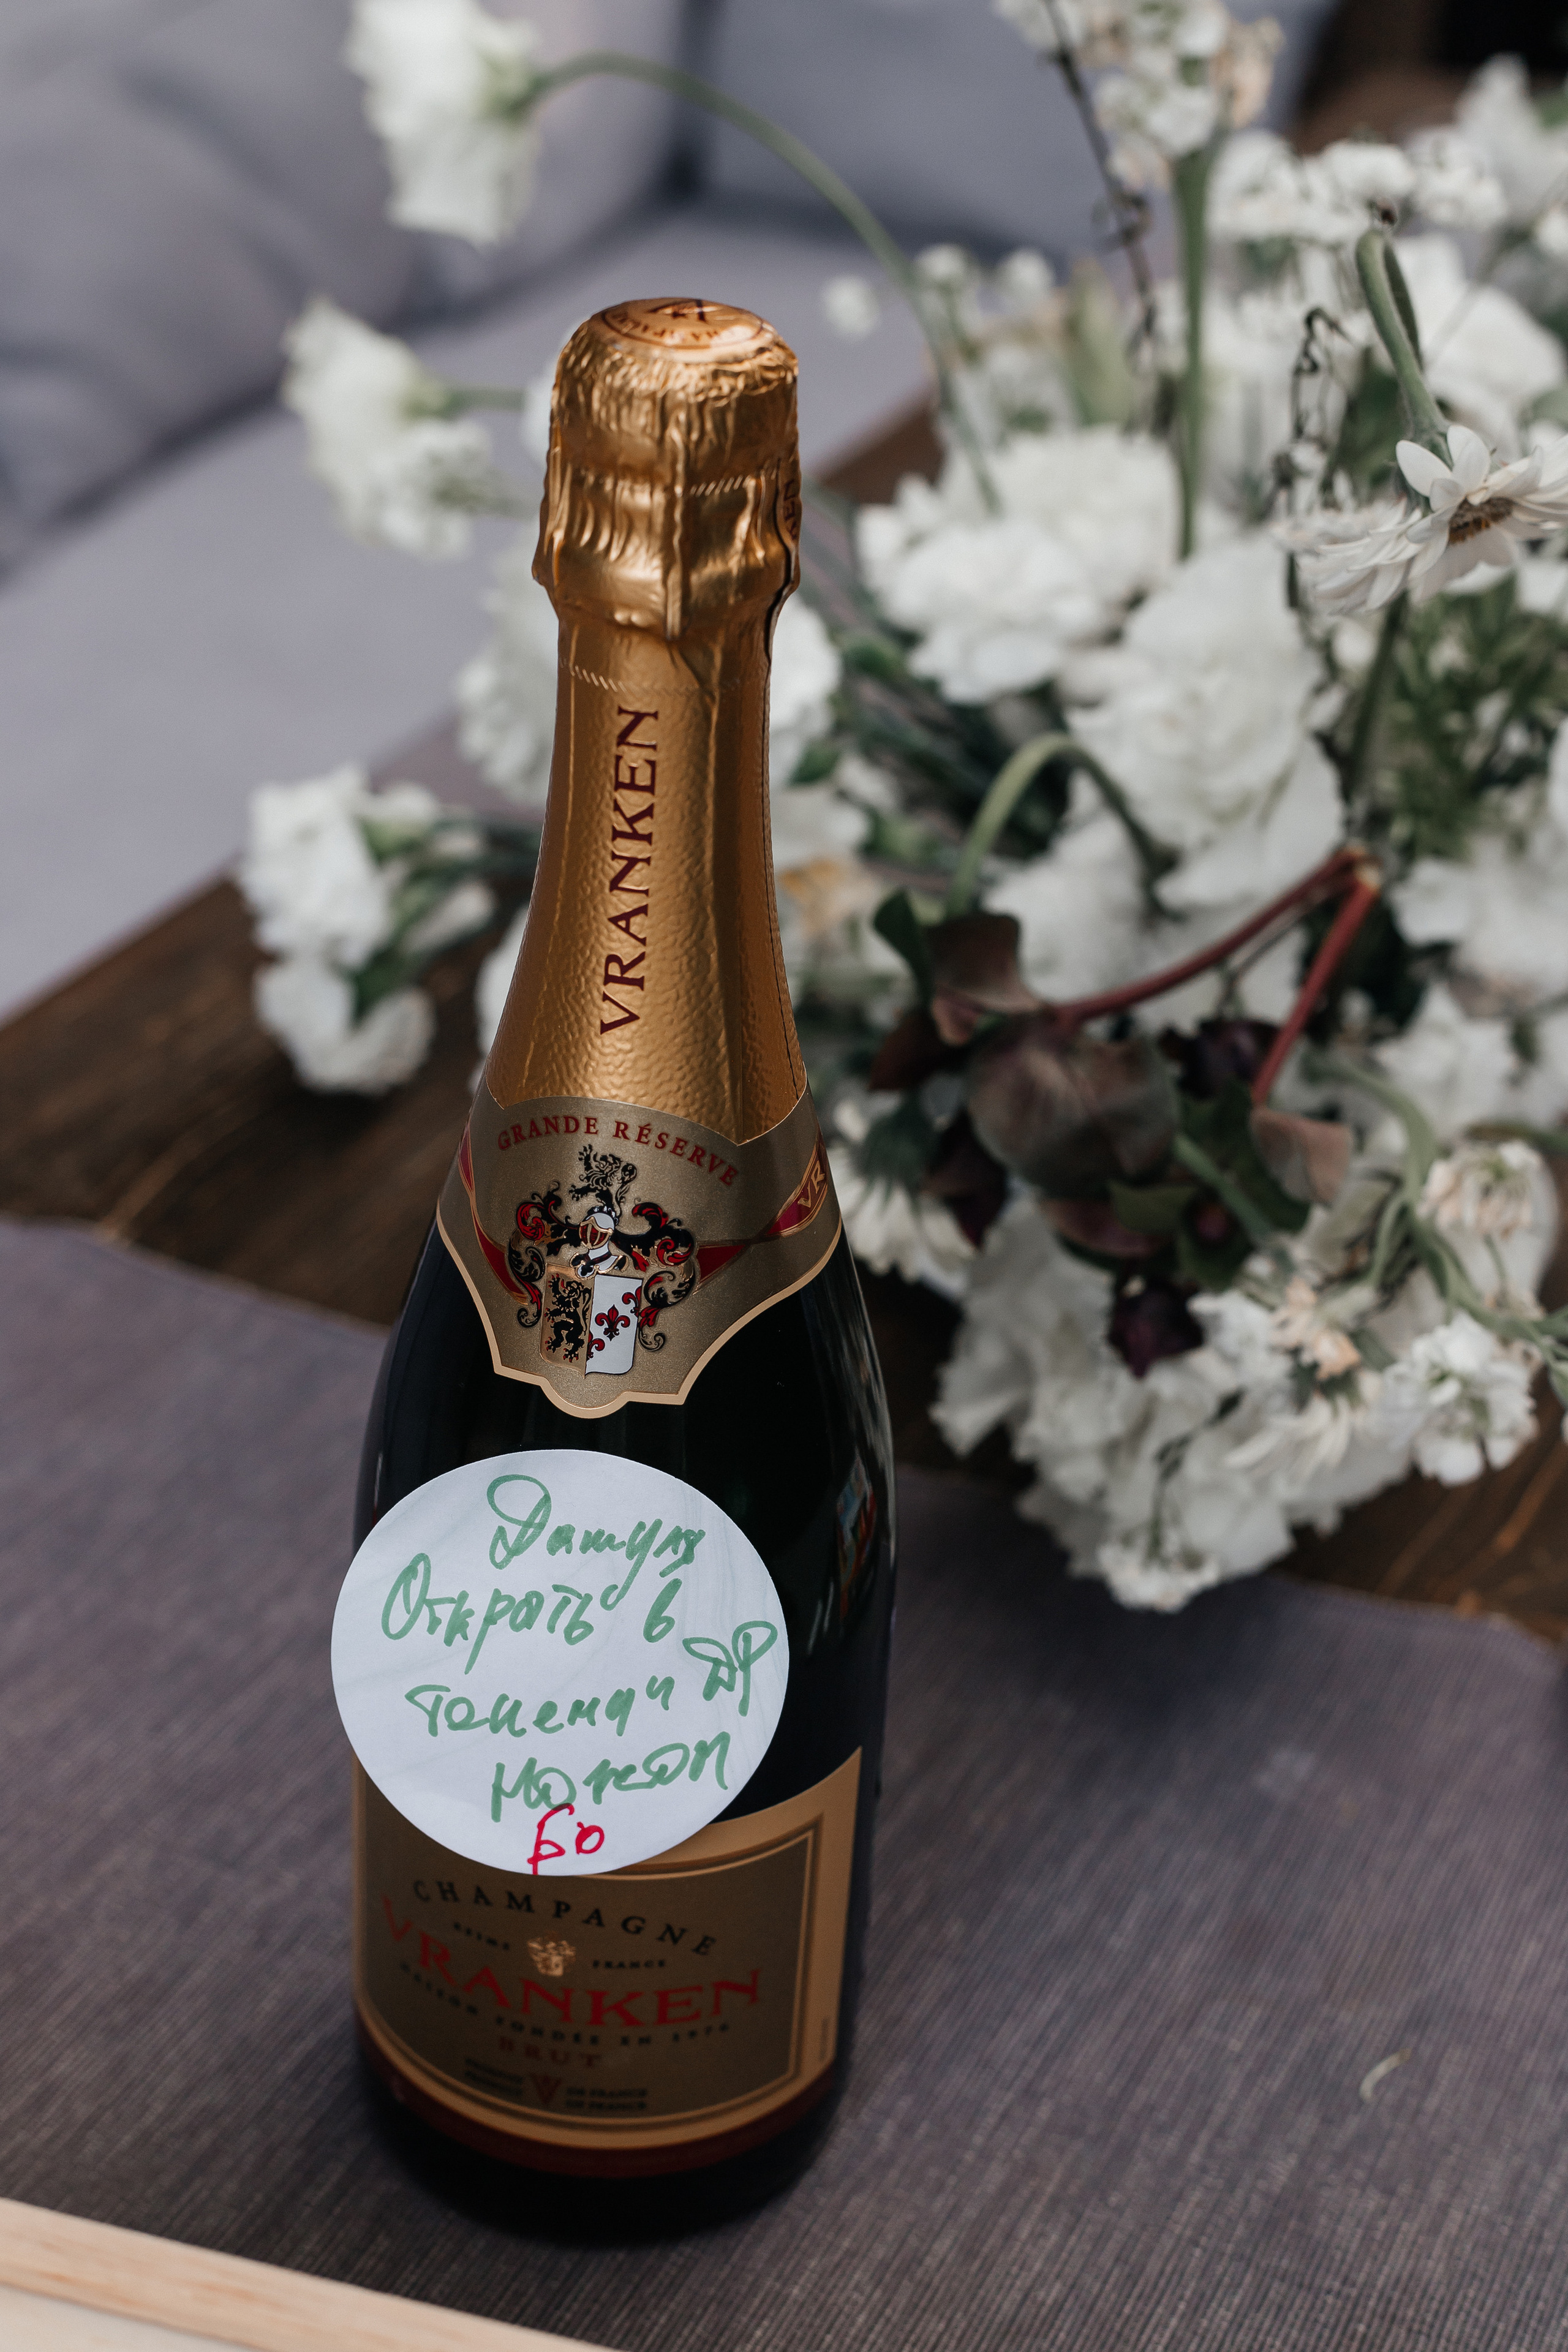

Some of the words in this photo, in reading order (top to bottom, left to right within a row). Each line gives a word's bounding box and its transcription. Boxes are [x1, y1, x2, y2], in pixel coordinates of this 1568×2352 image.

[600, 706, 658, 1035] VRANKEN
[497, 1116, 598, 1152] GRANDE
[613, 1120, 739, 1187] RÉSERVE
[413, 1879, 717, 1956] CHAMPAGNE
[382, 1893, 761, 2027] VRANKEN
[498, 2036, 601, 2068] BRUT
